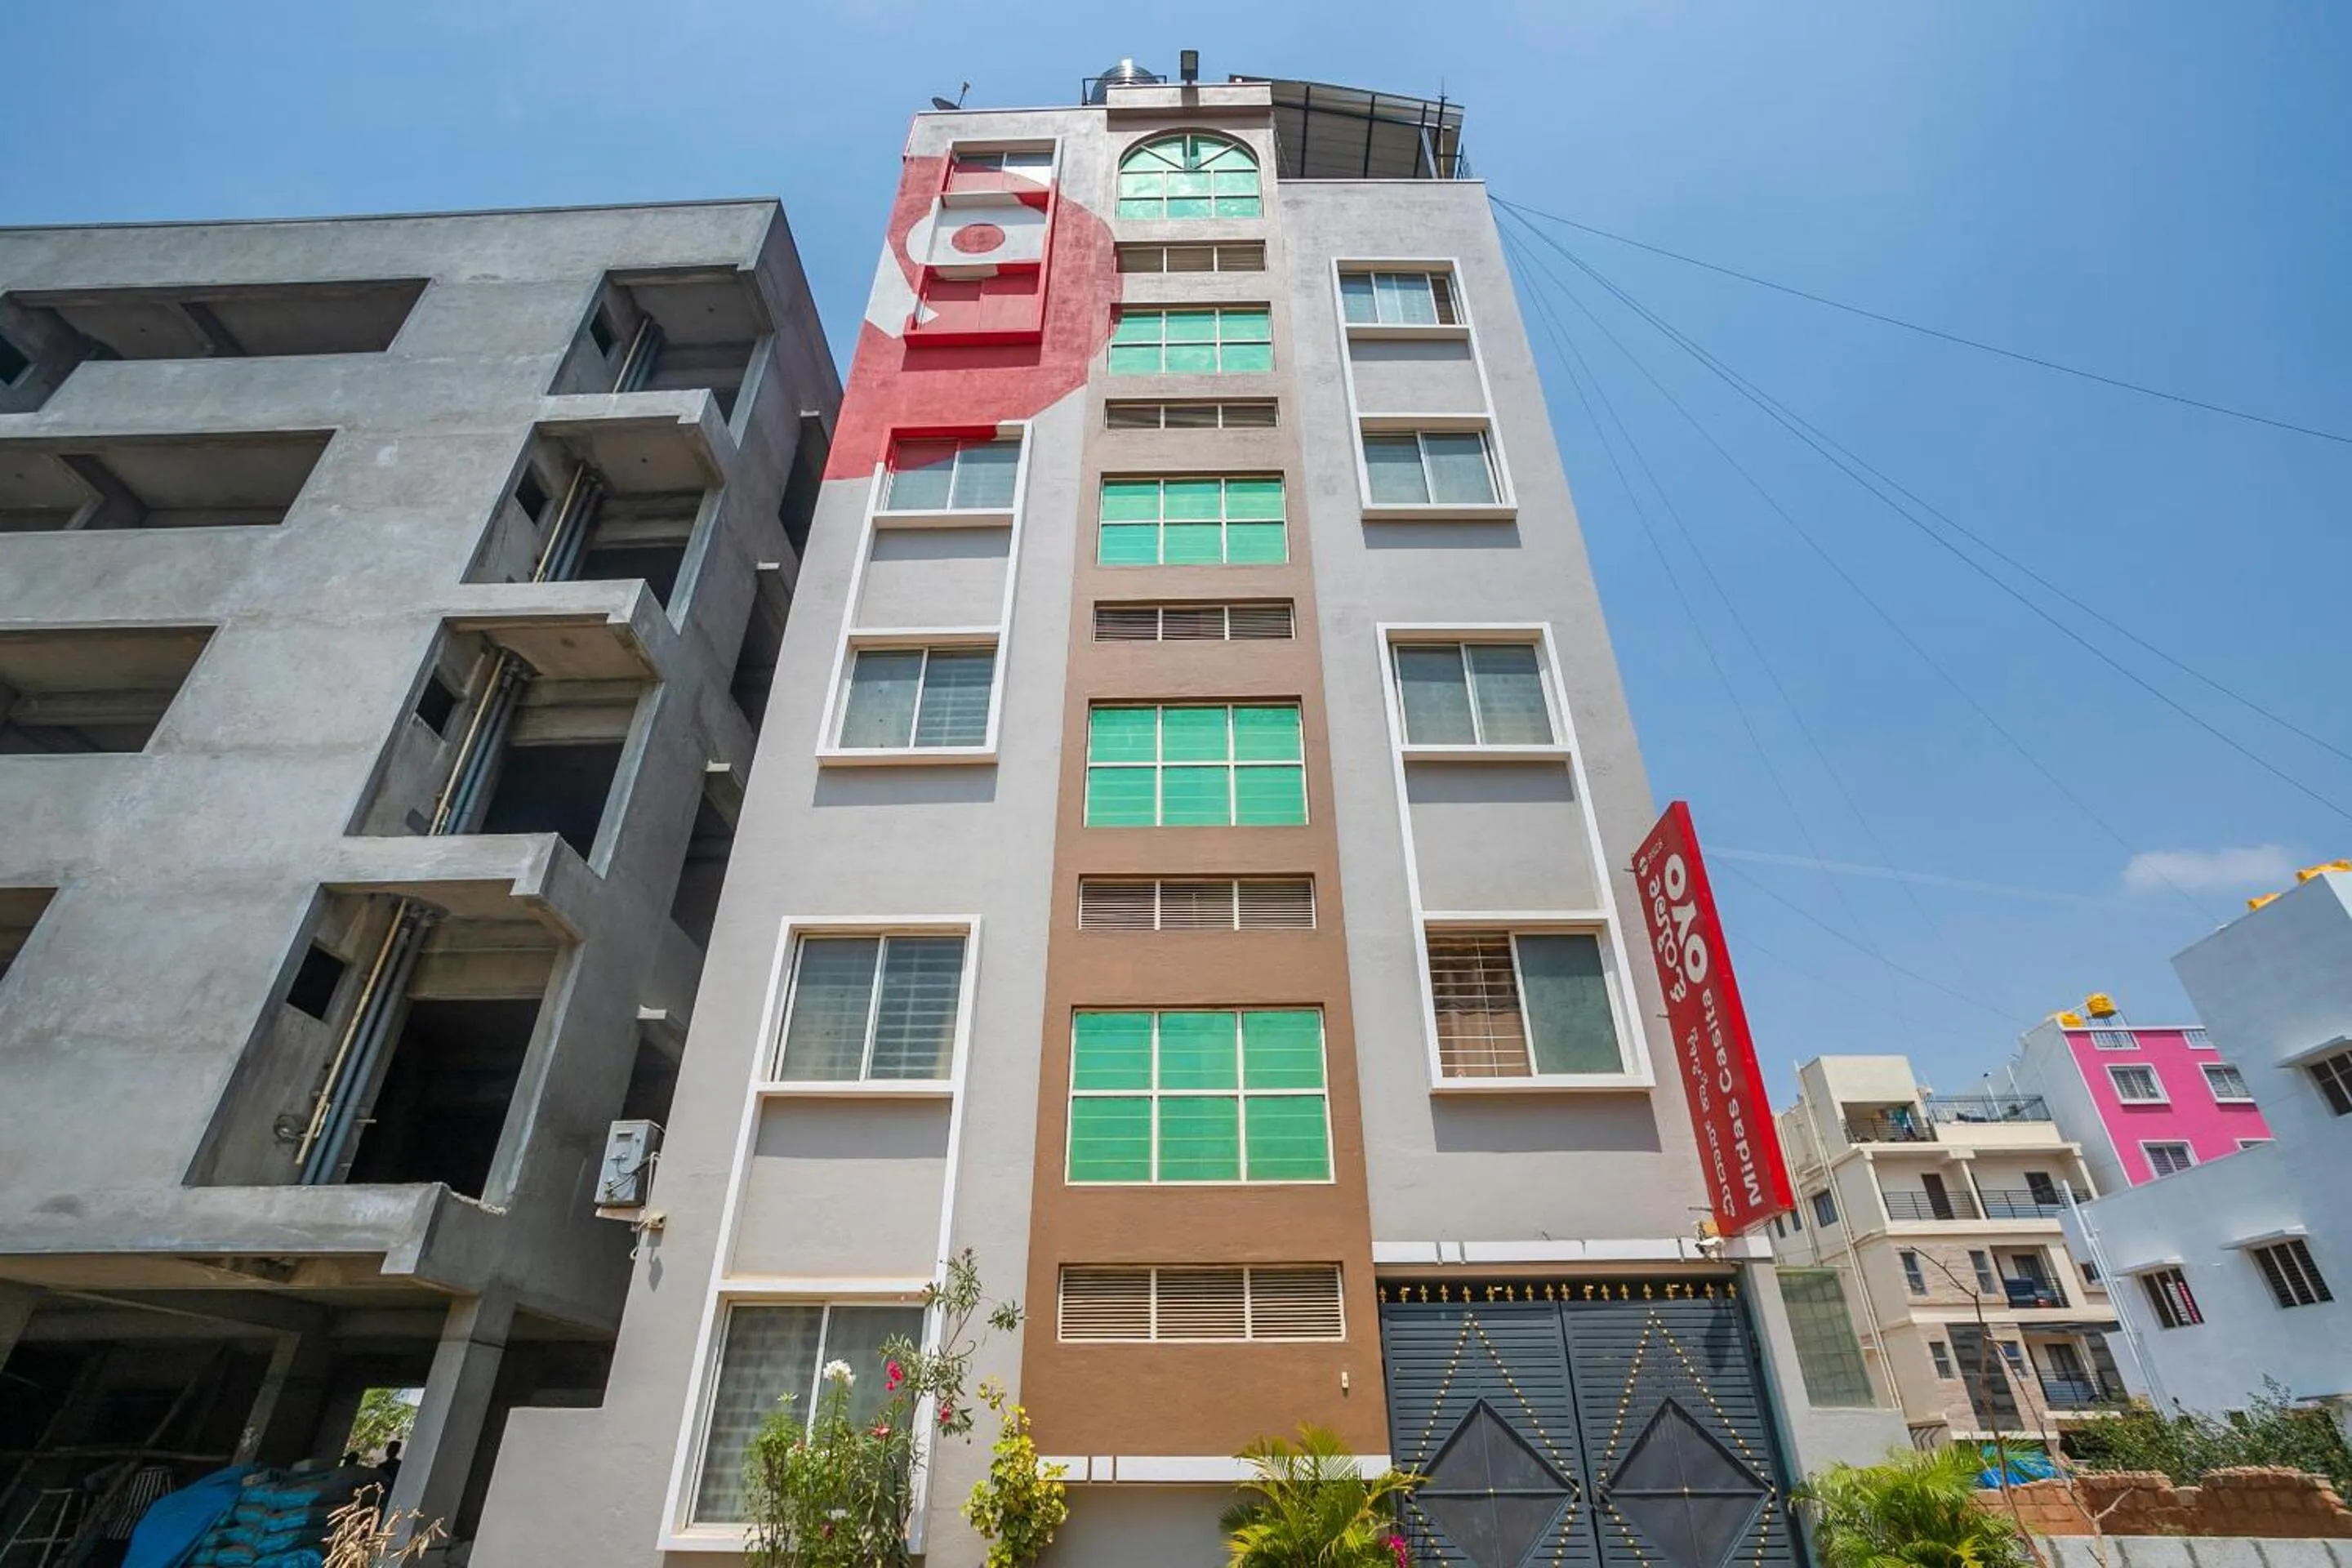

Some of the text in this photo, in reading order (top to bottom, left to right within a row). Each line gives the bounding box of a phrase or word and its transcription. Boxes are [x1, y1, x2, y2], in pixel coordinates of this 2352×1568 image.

[1665, 853, 1708, 983] OYO
[1703, 987, 1763, 1205] Midas Casita
